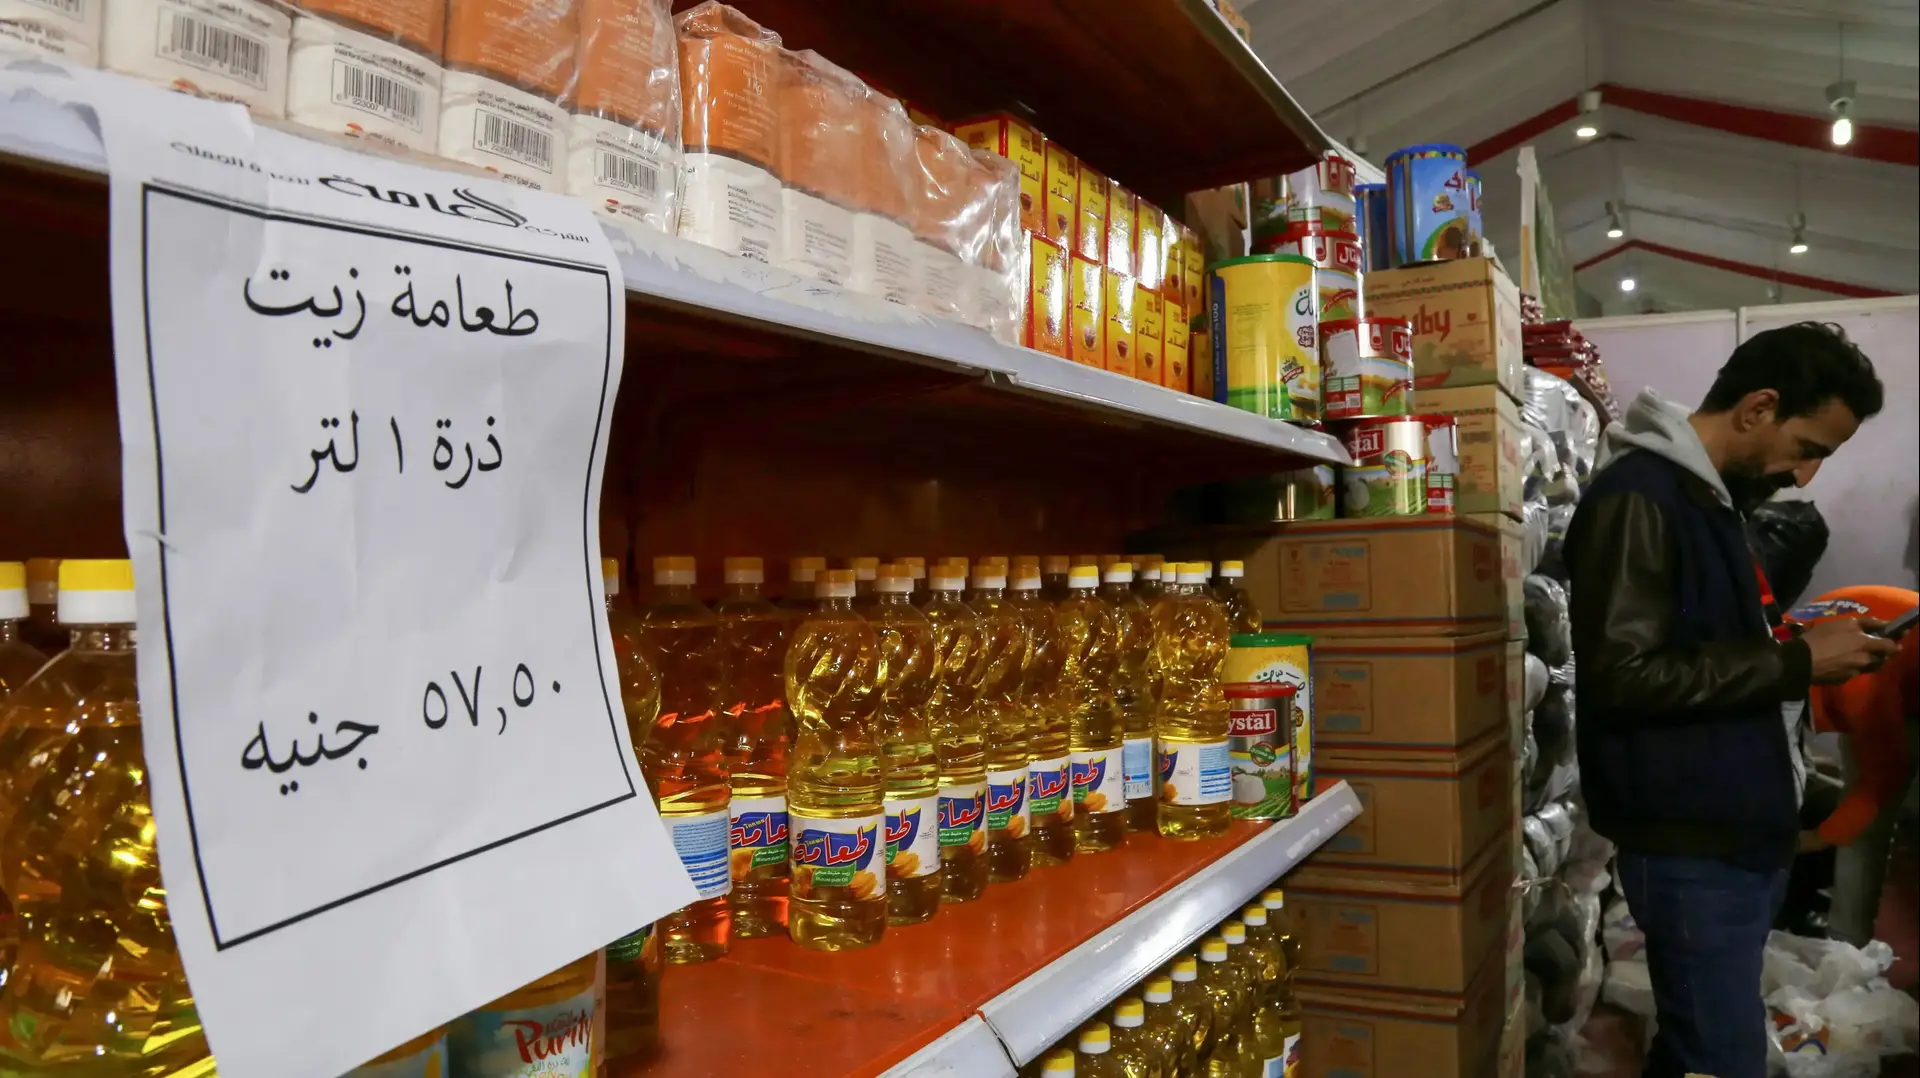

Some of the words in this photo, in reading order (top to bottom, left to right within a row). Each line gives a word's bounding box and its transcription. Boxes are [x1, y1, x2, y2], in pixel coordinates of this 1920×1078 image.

[245, 268, 365, 347] زيت
[391, 265, 539, 337] طعامة
[292, 411, 358, 493] لتر
[391, 417, 402, 473] ١
[434, 416, 502, 489] ذرة
[242, 712, 379, 795] جنيه
[1227, 712, 1272, 735] ystal
[794, 825, 869, 866] طعامة
[503, 1009, 594, 1064] Purity
